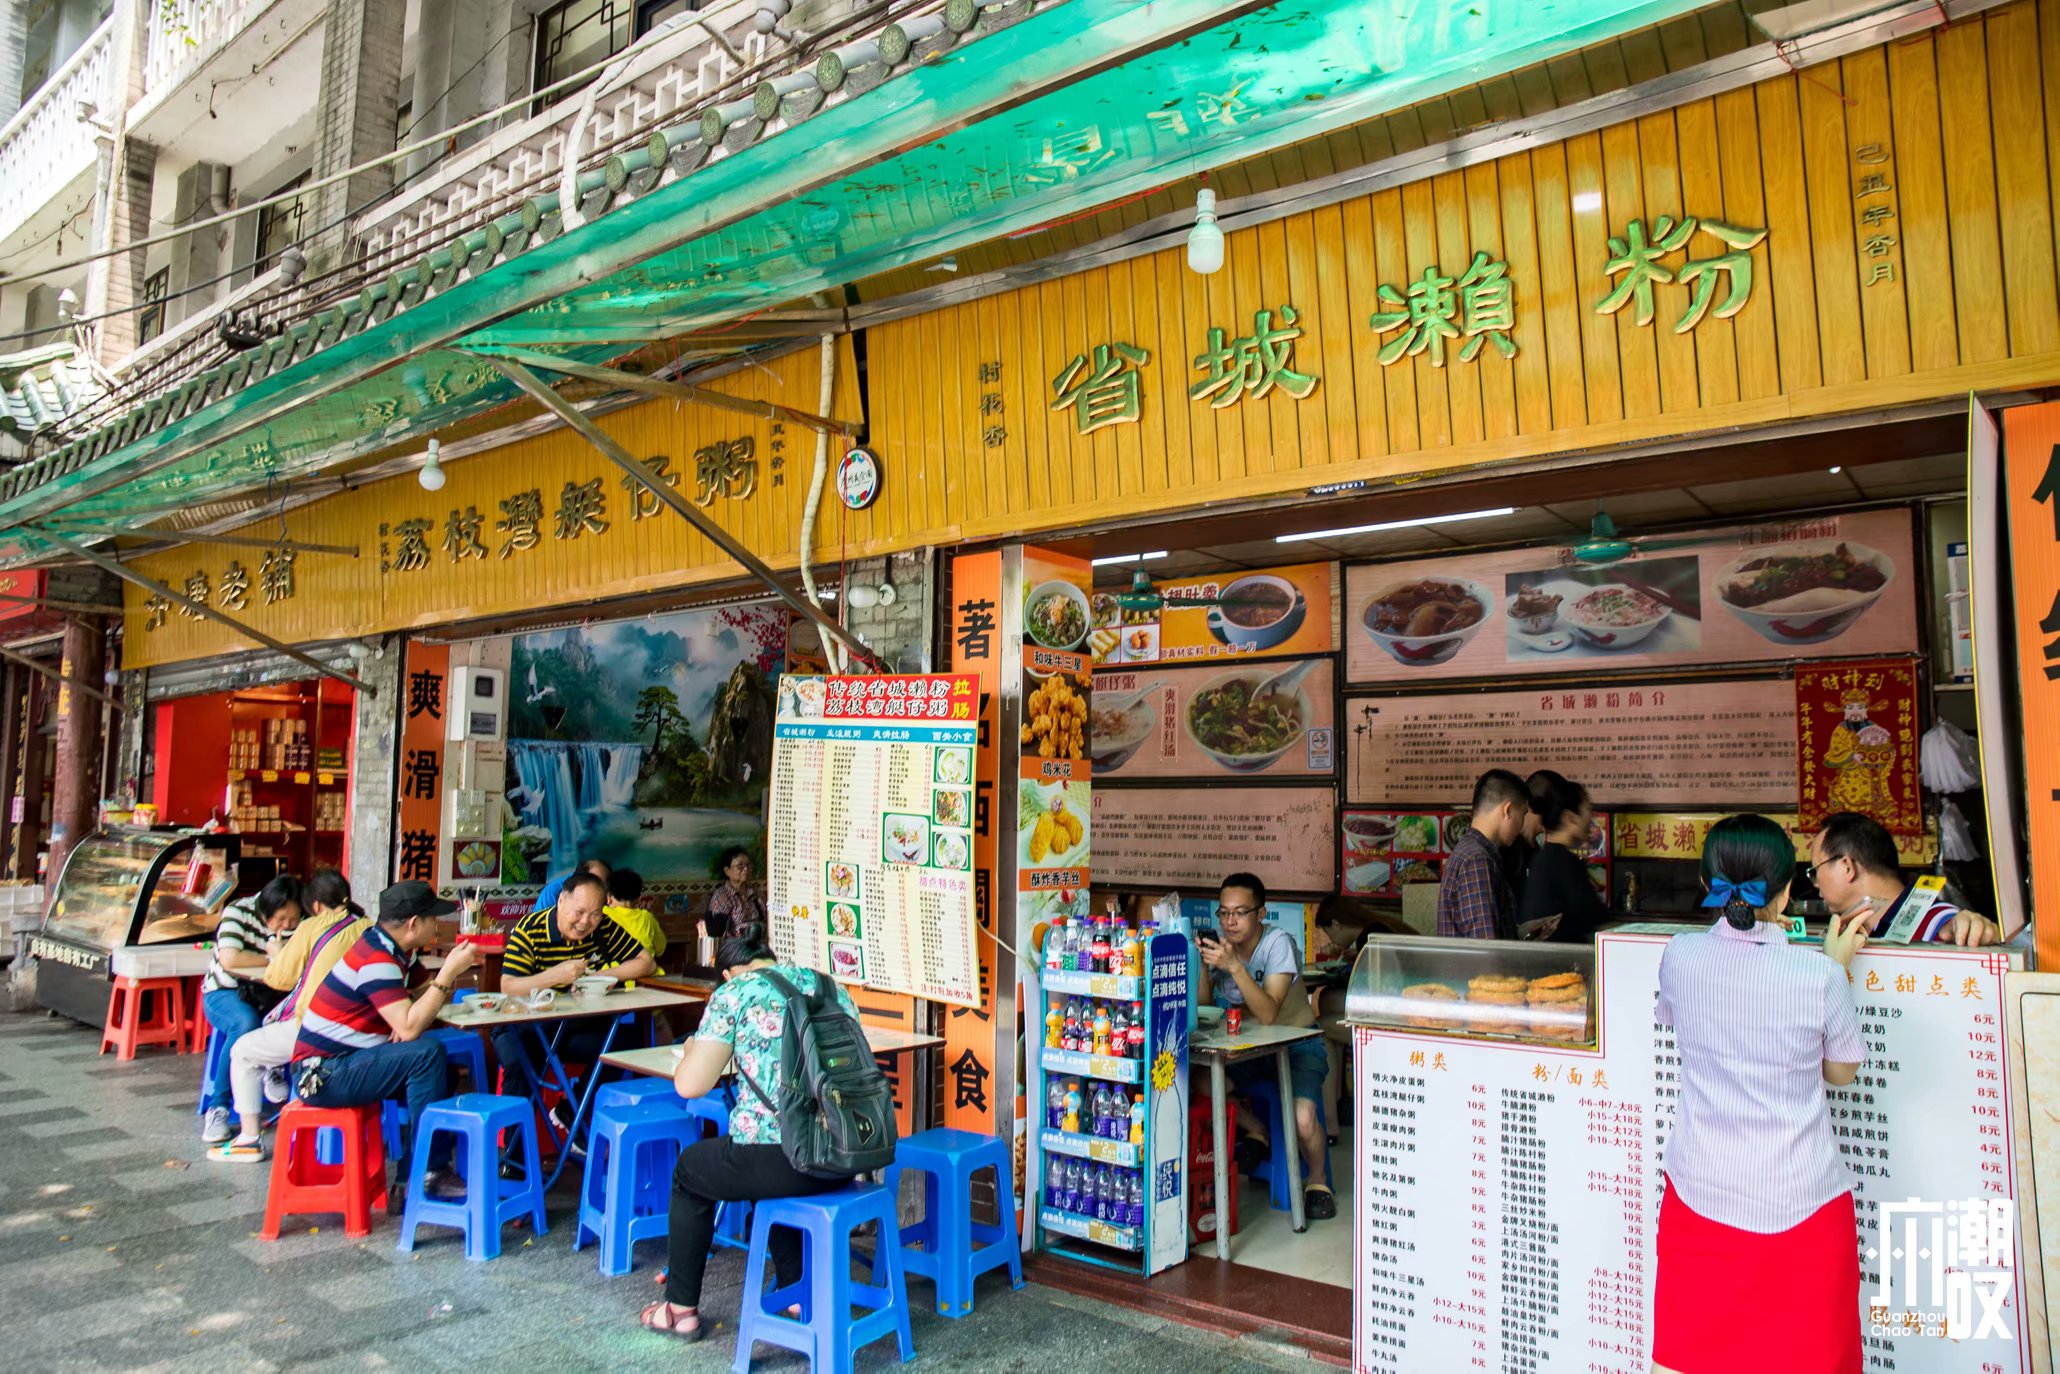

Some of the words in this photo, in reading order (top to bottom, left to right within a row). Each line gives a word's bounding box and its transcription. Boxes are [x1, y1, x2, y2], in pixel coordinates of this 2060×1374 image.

[1034, 650, 1082, 672] 和味牛三星
[1540, 691, 1665, 711] 省城濑粉简介
[1164, 688, 1176, 757] 爽滑猪红汤
[1042, 762, 1072, 778] 鸡米花
[1030, 868, 1080, 890] 酥炸香芋丝
[1152, 961, 1187, 980] 点滴信任
[1152, 979, 1187, 999] 点滴纯悦
[1847, 968, 1984, 1001] 色甜点类
[1856, 1006, 1902, 1019] /绿豆沙
[1974, 1014, 1995, 1025] 6元
[1968, 1032, 1996, 1043] 10元
[1409, 1050, 1448, 1072] 粥类
[1969, 1050, 1997, 1062] 12元
[1976, 1069, 1998, 1080] 8元
[1472, 1085, 1486, 1094] 6元
[1978, 1087, 1999, 1099] 8元
[1467, 1101, 1486, 1111] 10元
[1971, 1105, 2000, 1118] 10元
[1472, 1119, 1486, 1128] 8元
[1979, 1124, 2001, 1136] 8元
[1472, 1136, 1486, 1145] 7元
[1980, 1143, 2002, 1155] 4元
[1373, 1154, 1397, 1166] 猪肚粥
[1472, 1152, 1486, 1162] 7元
[1628, 1152, 1642, 1162] 5元
[1628, 1164, 1642, 1174] 5元
[1845, 1161, 1891, 1178] 地瓜丸
[1981, 1161, 2003, 1174] 6元
[1472, 1170, 1486, 1179] 8元
[1471, 1187, 1486, 1196] 9元
[1982, 1180, 2004, 1193] 7元
[1471, 1204, 1486, 1213] 8元
[1624, 1200, 1643, 1211] 10元
[1624, 1212, 1643, 1224] 10元
[1472, 1220, 1486, 1230] 3元
[1628, 1225, 1643, 1236] 9元
[1471, 1238, 1486, 1247] 6元
[1624, 1236, 1643, 1248] 10元
[1471, 1255, 1486, 1264] 6元
[1628, 1249, 1643, 1260] 6元
[1628, 1262, 1643, 1273] 6元
[1467, 1271, 1486, 1281] 10元
[1472, 1289, 1486, 1298] 9元
[1472, 1340, 1486, 1350] 7元
[1630, 1336, 1644, 1346] 7元
[1472, 1357, 1486, 1367] 8元
[1630, 1360, 1644, 1371] 7元
[1863, 1354, 1896, 1371] 肉肠
